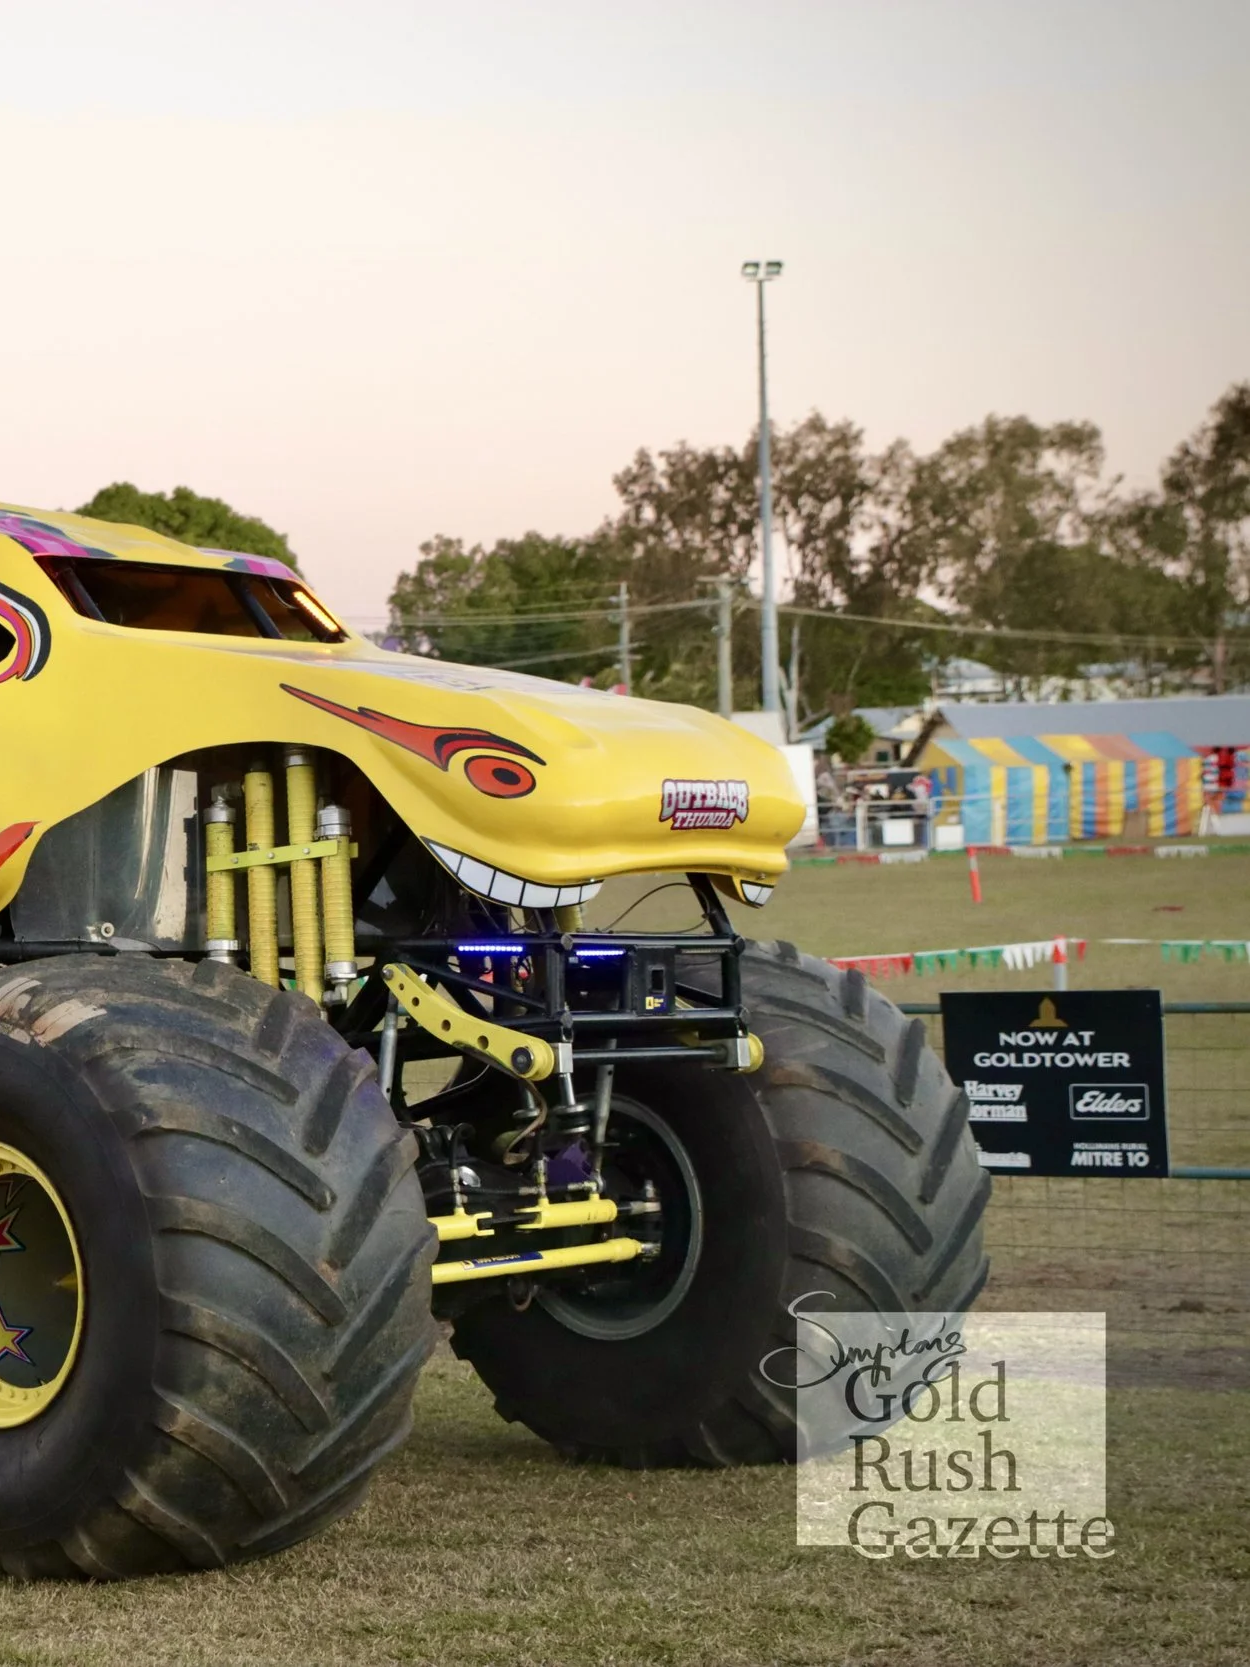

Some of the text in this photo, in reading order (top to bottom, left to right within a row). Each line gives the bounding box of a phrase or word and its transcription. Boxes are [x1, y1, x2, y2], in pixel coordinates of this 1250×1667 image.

[661, 780, 748, 821] OUTBACK
[673, 811, 736, 828] THUNDA
[998, 1031, 1095, 1047] NOW AT
[973, 1052, 1131, 1068] GOLDTOWER
[964, 1080, 1024, 1101] Harvey
[1075, 1090, 1144, 1113] Elders
[968, 1101, 1028, 1122] orman
[1070, 1151, 1150, 1167] MITRE 10
